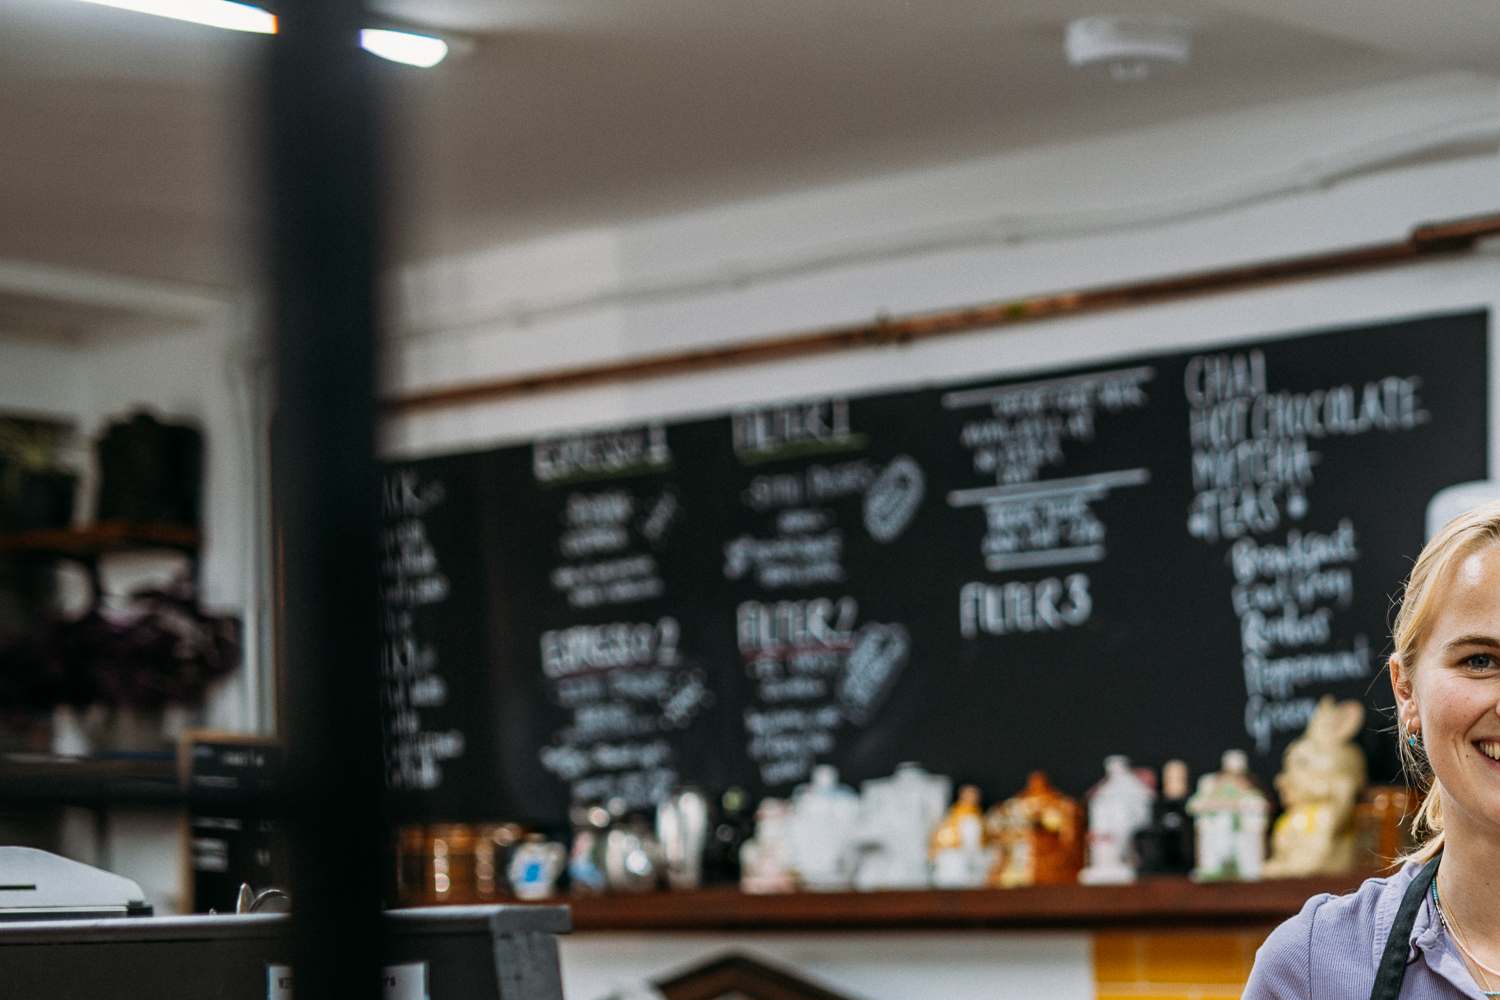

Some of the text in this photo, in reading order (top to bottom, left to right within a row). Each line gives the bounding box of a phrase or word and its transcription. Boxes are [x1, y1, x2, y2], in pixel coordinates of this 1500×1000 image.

[1190, 376, 1431, 449] HOT CHOCOLATE
[959, 578, 1066, 641] FILTER
